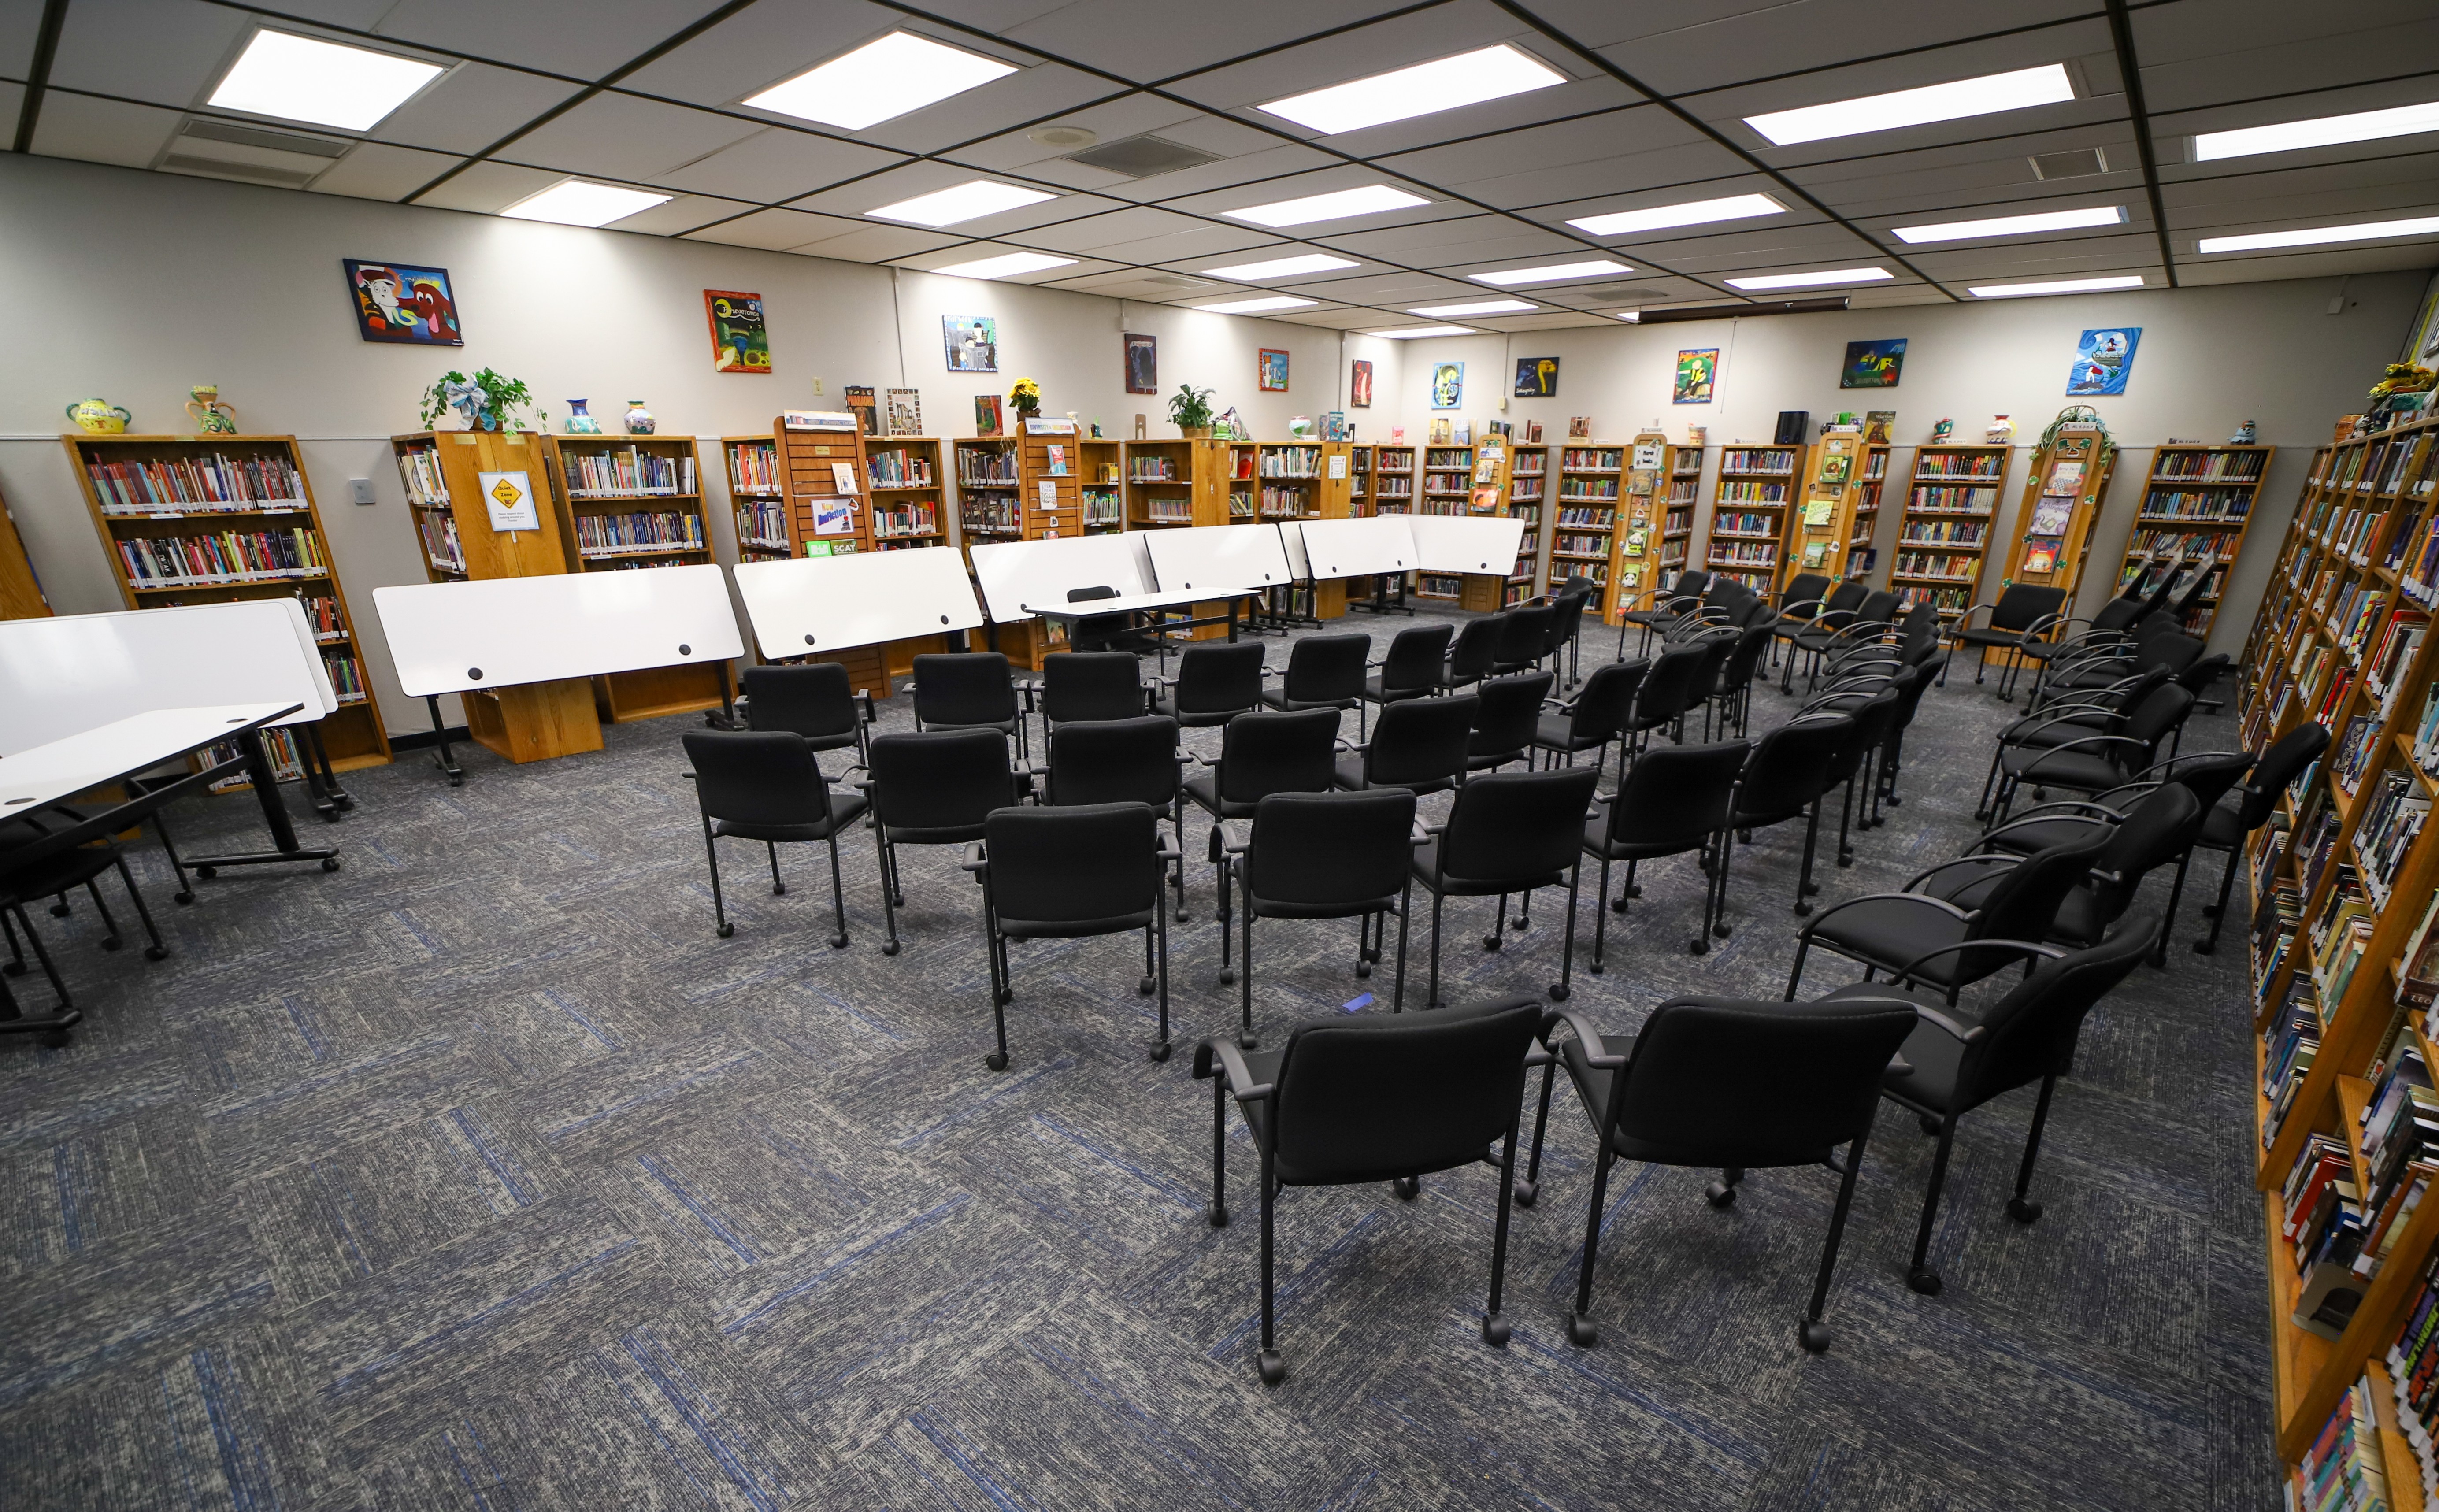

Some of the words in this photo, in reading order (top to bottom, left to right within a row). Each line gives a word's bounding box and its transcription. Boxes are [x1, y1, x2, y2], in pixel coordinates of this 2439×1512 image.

[397, 274, 433, 283] Creativity
[722, 306, 759, 317] Prseverance
[159, 554, 171, 573] TWEAK
